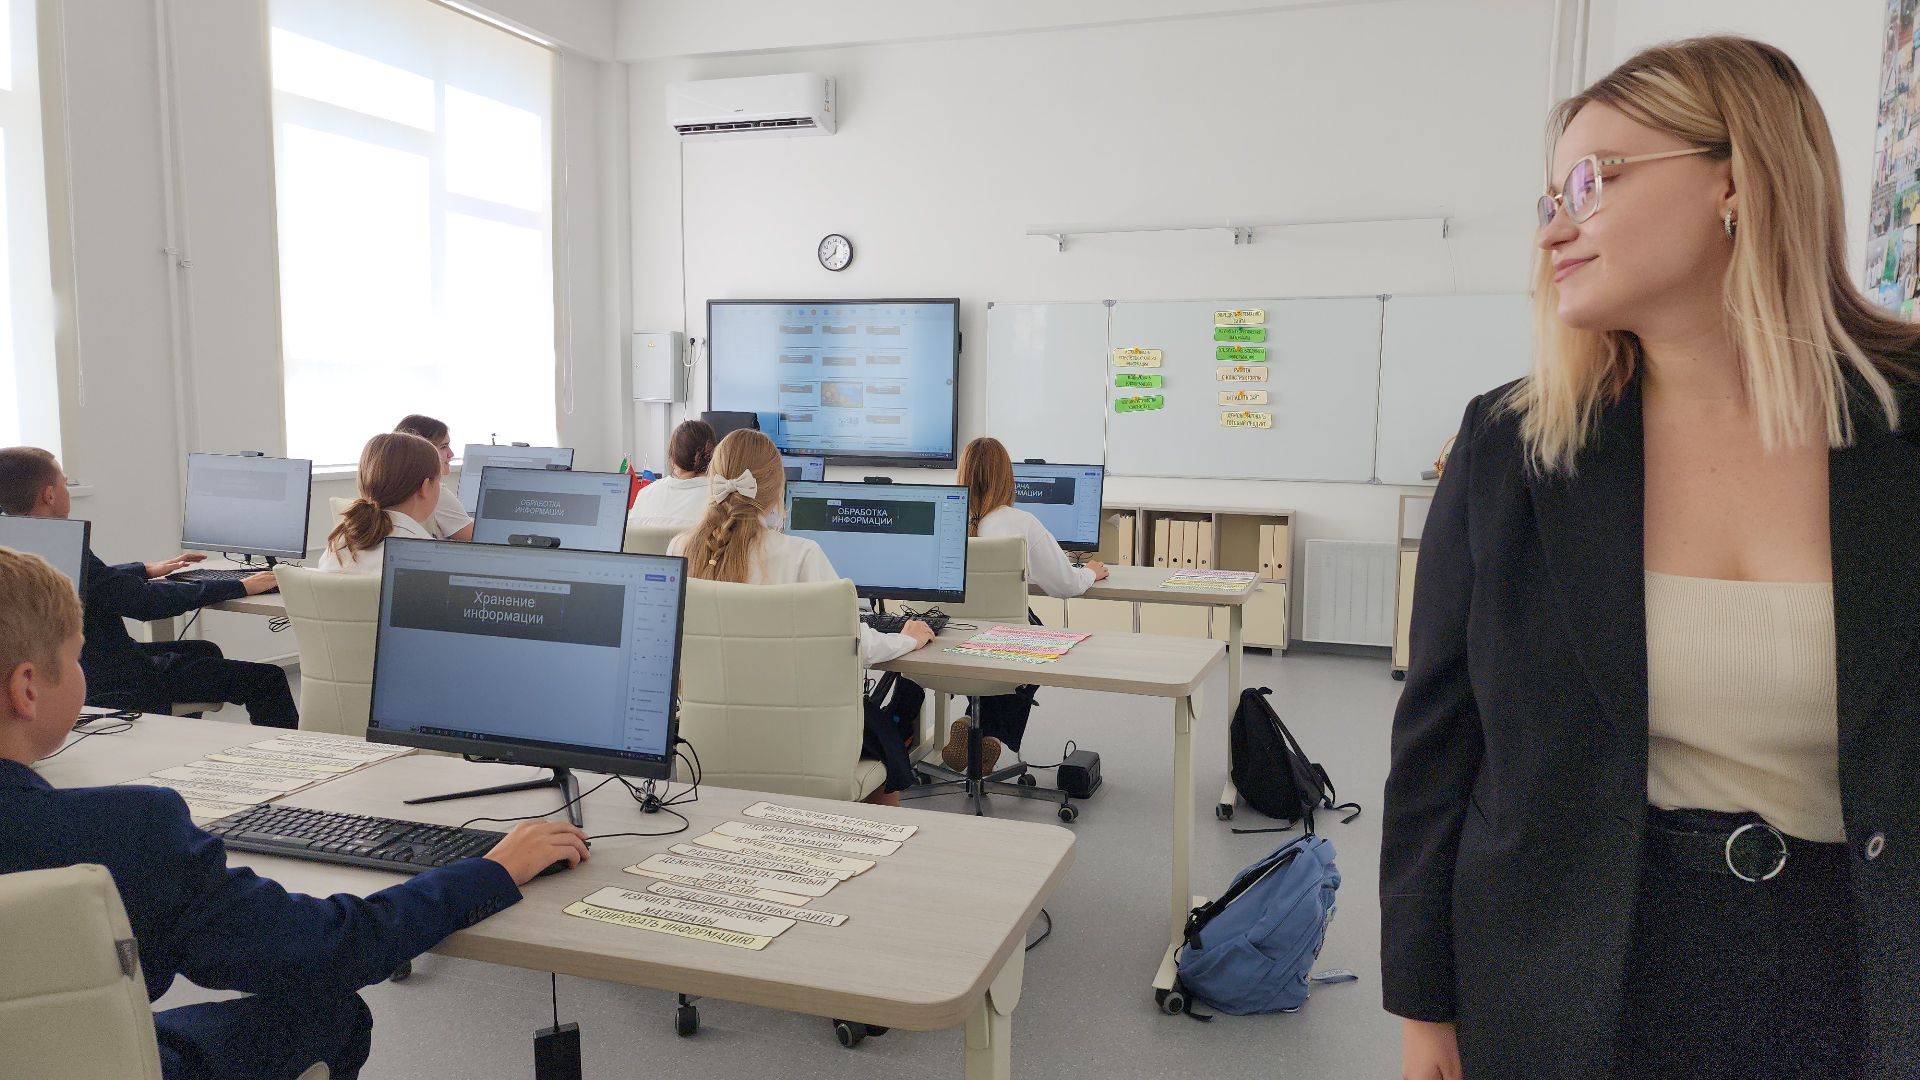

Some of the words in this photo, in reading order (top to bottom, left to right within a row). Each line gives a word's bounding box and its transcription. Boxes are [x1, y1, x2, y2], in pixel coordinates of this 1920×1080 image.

[514, 506, 565, 516] ИНФОРМАЦИИ
[520, 499, 561, 508] ОБРАБОТКА
[838, 507, 888, 518] ОБРАБОТКА
[832, 516, 893, 526] ИНФОРМАЦИИ
[474, 591, 536, 608] Хранение
[463, 606, 544, 625] информации
[765, 805, 838, 822] ИСПОЛЬЗОВАТЬ
[842, 818, 905, 834] УСТРОЙСТВА
[742, 824, 795, 836] ОТОБРАТЬ
[798, 829, 884, 846] НЕОБХОДИМУЮ
[761, 834, 843, 850] ИНФОРМАЦИЮ
[733, 836, 777, 850] ИЗУЧИТЬ
[778, 844, 844, 864] УСТРОЙСТВА
[658, 856, 770, 878] ДЕМОНСТРИРОВАТЬ
[772, 871, 828, 887] ГОТОВЫЙ
[686, 848, 728, 862] РАБОТА
[729, 856, 738, 864] С
[741, 857, 834, 878] КОНСТРУКТОРОМ
[702, 872, 759, 886] ПРОДУКТ
[727, 883, 760, 896] САЙТ
[620, 892, 672, 906] ИЗУЧИТЬ
[674, 900, 768, 924] ТЕОРЕТИЧЕСКИЕ
[656, 886, 730, 905] ОПРЕДЕЛИТЬ
[731, 898, 794, 916] ТЕМАТИКУ
[794, 912, 836, 925] САЙТА
[640, 906, 720, 926] МАТЕРИАЛЫ
[580, 907, 660, 928] КОДИРОВАТЬ
[662, 919, 756, 946] ИНФОРМАЦИЮ
